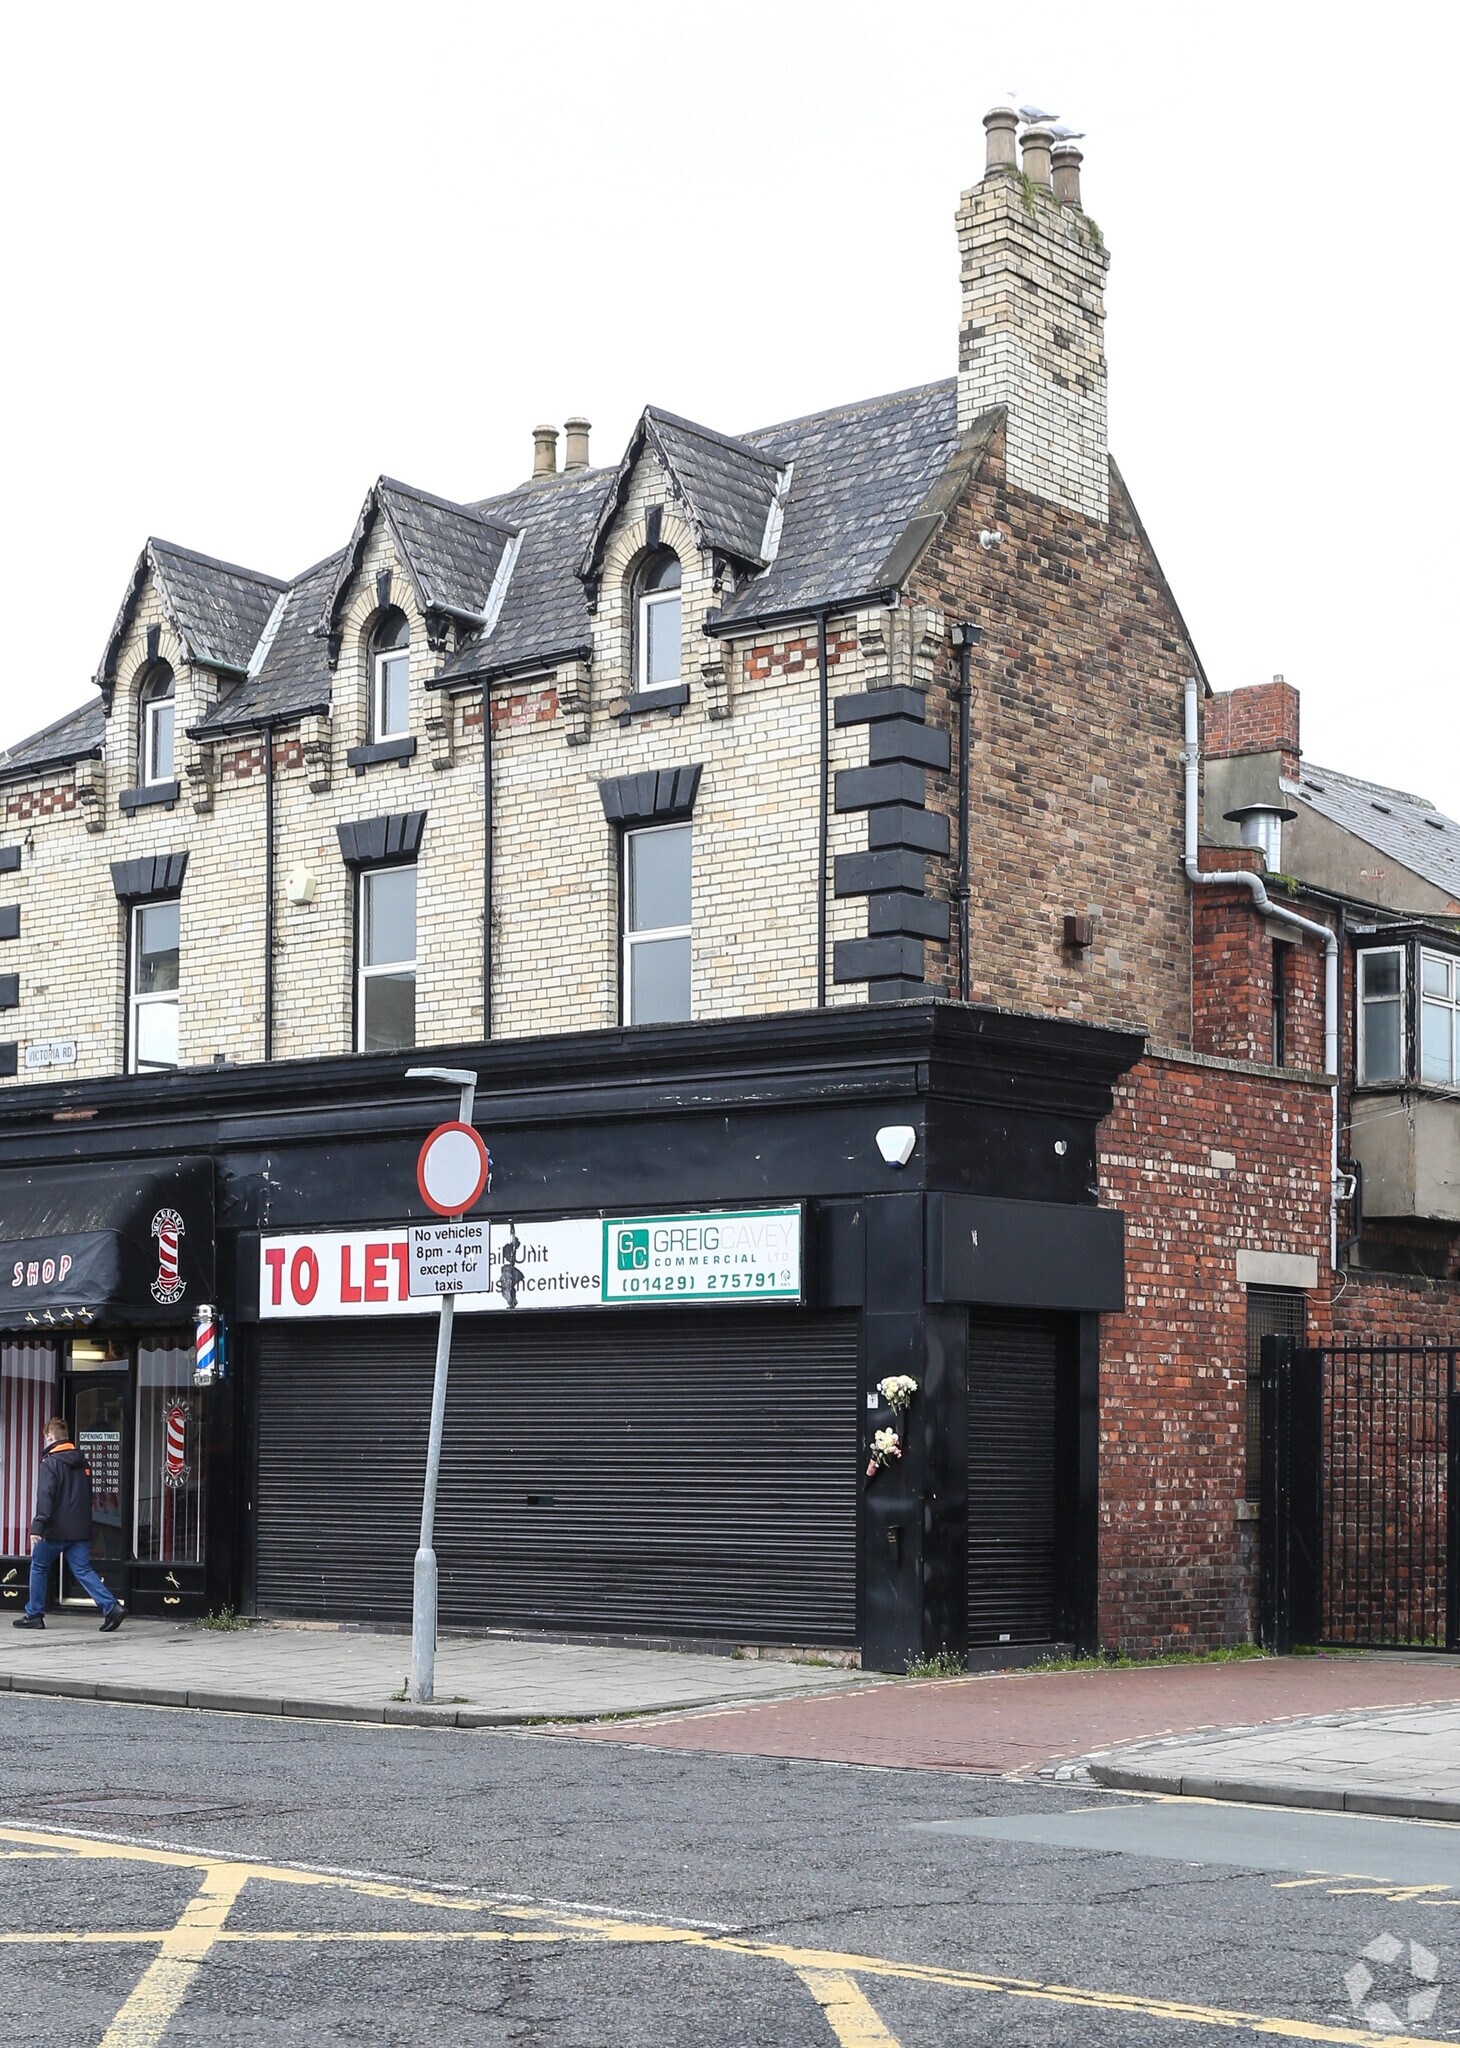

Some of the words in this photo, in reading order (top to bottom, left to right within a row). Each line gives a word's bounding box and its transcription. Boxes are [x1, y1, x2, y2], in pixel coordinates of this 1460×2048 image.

[29, 1048, 60, 1062] VICTORIA
[415, 1229, 431, 1242] No
[434, 1226, 482, 1240] vehicles
[416, 1246, 443, 1261] 8pm
[455, 1243, 482, 1258] 4pm
[514, 1244, 549, 1264] Unit
[654, 1253, 757, 1267] COMMERCIAL
[767, 1252, 789, 1262] LTD
[11, 1254, 73, 1287] SHOP
[265, 1245, 319, 1306] TO
[340, 1242, 409, 1303] LET
[420, 1262, 458, 1277] except
[461, 1260, 478, 1272] for
[435, 1279, 463, 1292] taxis
[514, 1272, 601, 1292] ncentives
[623, 1276, 695, 1292] (01429)
[707, 1272, 776, 1289] 275791
[155, 1291, 180, 1302] SHOP
